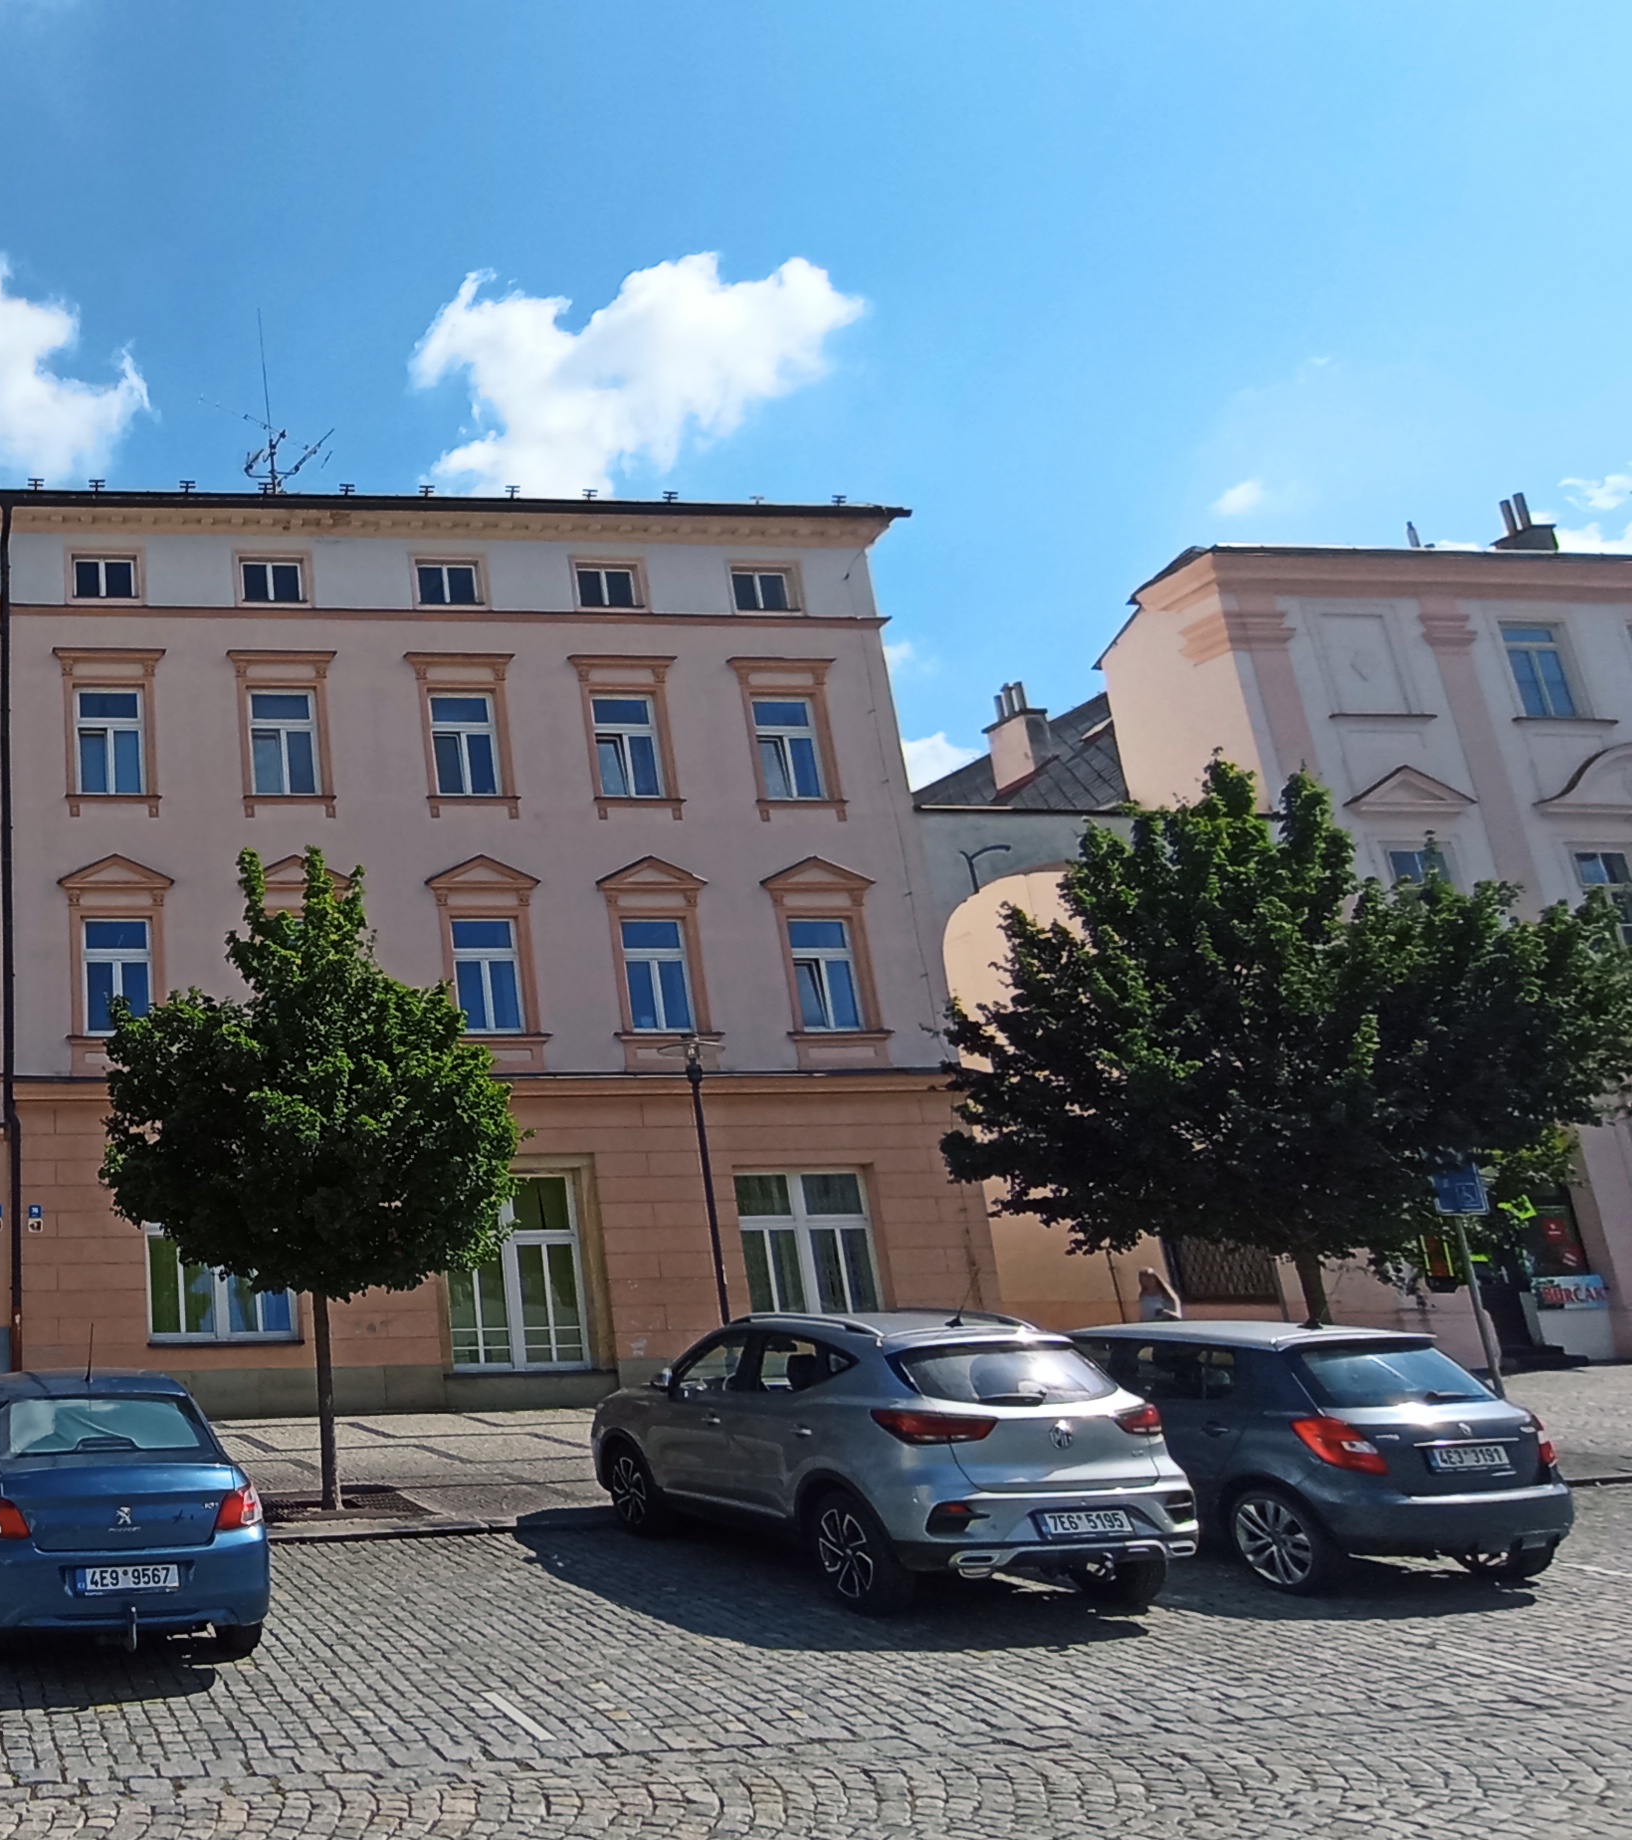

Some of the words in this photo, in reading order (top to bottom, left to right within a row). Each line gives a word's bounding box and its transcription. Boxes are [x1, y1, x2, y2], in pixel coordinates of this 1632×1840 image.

[1439, 1449, 1466, 1465] 4E3
[1048, 1515, 1079, 1531] 7E6
[1085, 1512, 1125, 1530] 5195
[90, 1569, 119, 1588] 4E9
[131, 1566, 170, 1585] 9567
